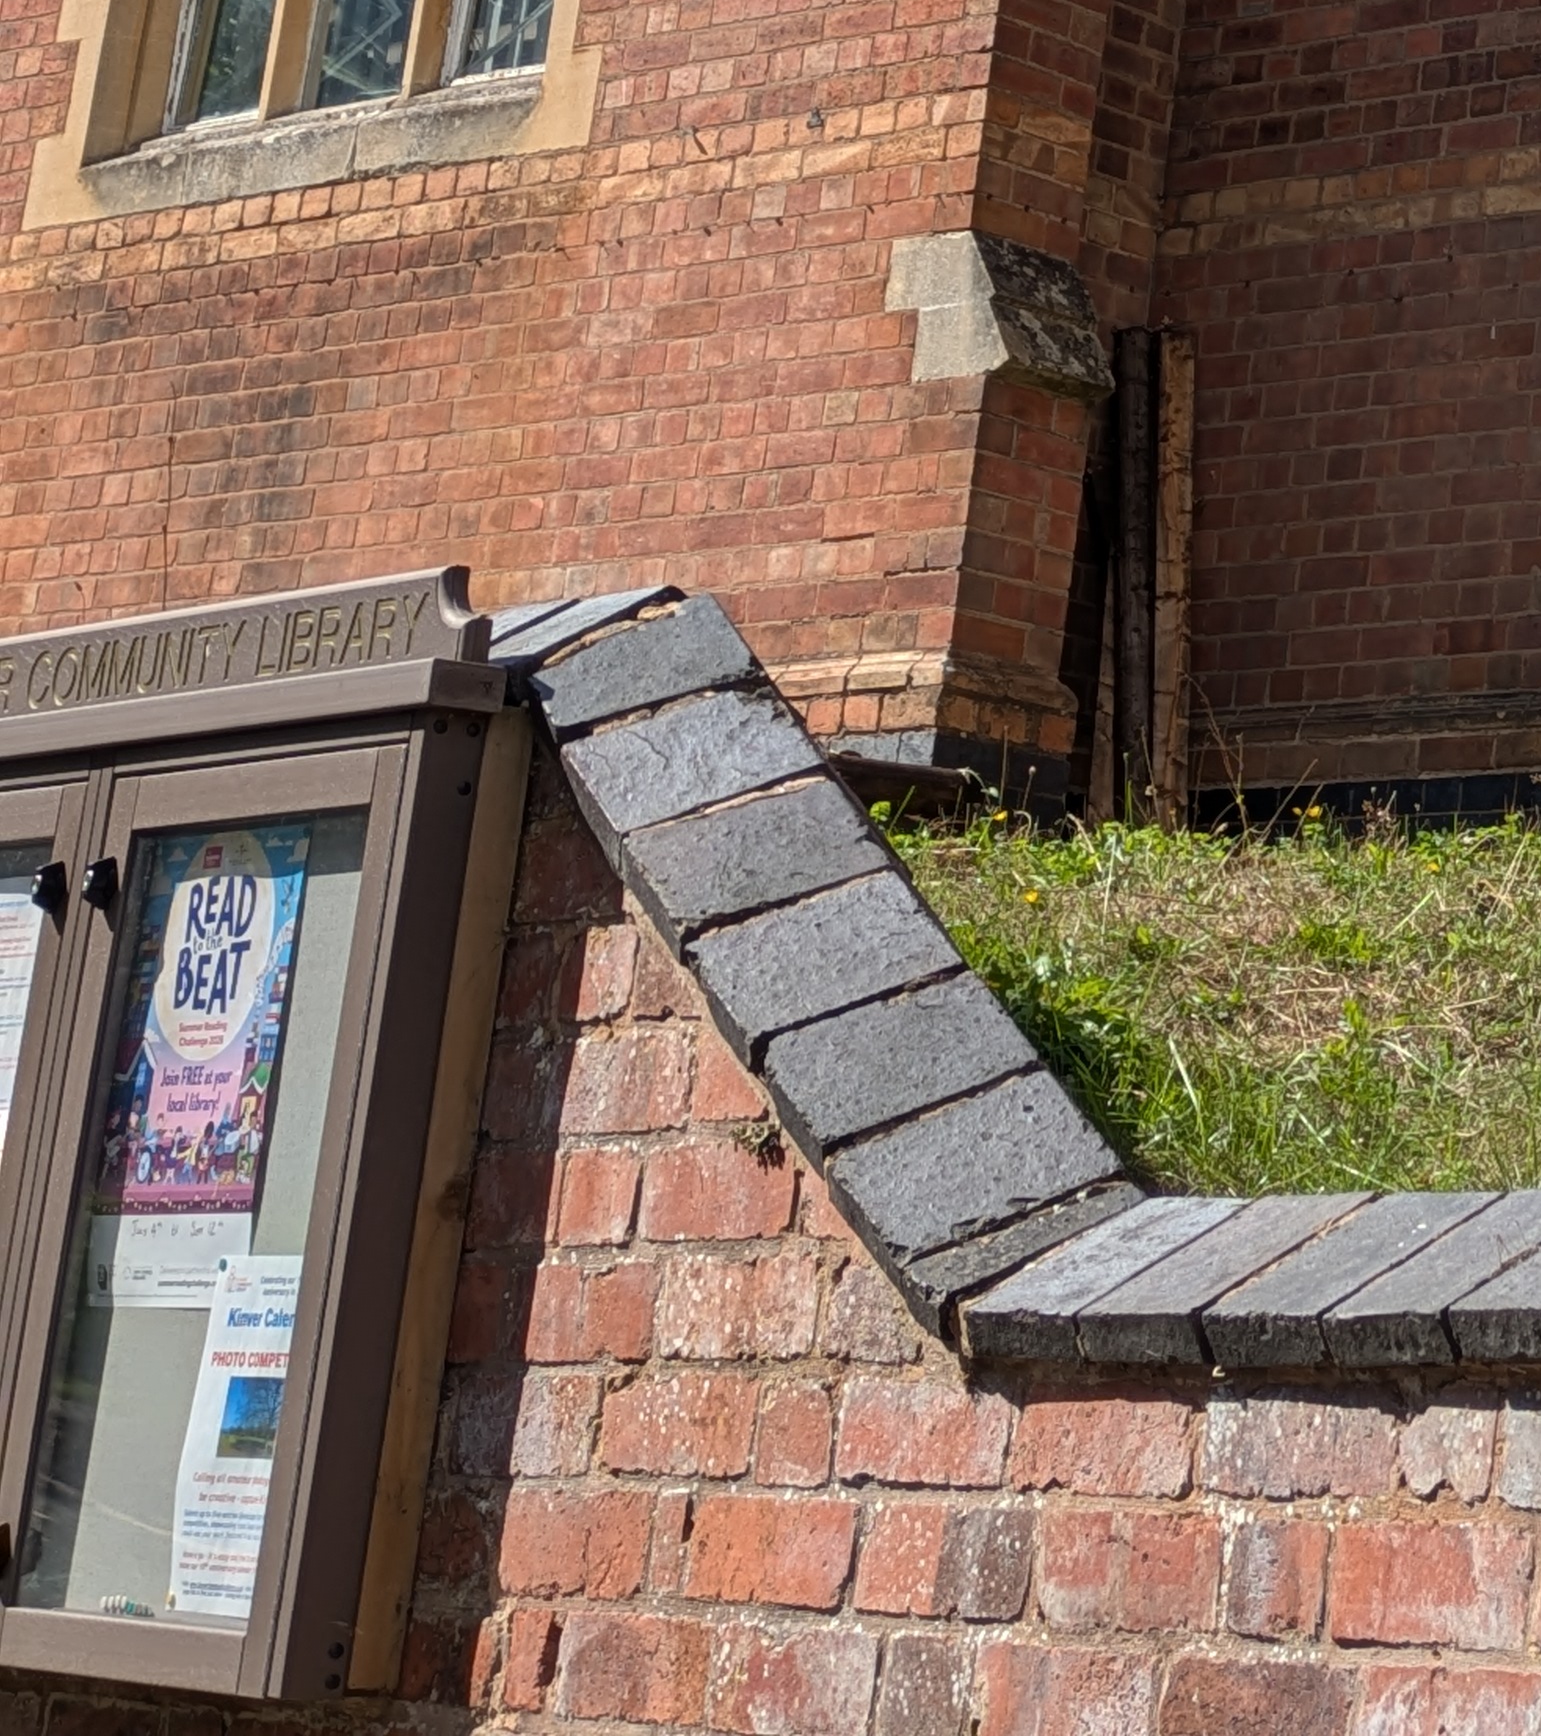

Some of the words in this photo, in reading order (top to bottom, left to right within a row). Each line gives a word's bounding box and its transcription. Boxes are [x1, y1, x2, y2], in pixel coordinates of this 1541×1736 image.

[27, 619, 248, 710] COMMUNITY
[254, 592, 430, 678] LIBRARY
[185, 874, 257, 943] READ
[193, 936, 204, 953] to
[206, 930, 223, 951] the
[174, 939, 251, 1015] BEAT
[180, 1066, 204, 1086] FREE
[212, 1070, 233, 1093] your
[166, 1091, 187, 1113] local
[227, 1308, 263, 1327] Kinver
[212, 1352, 245, 1368] PHOTO
